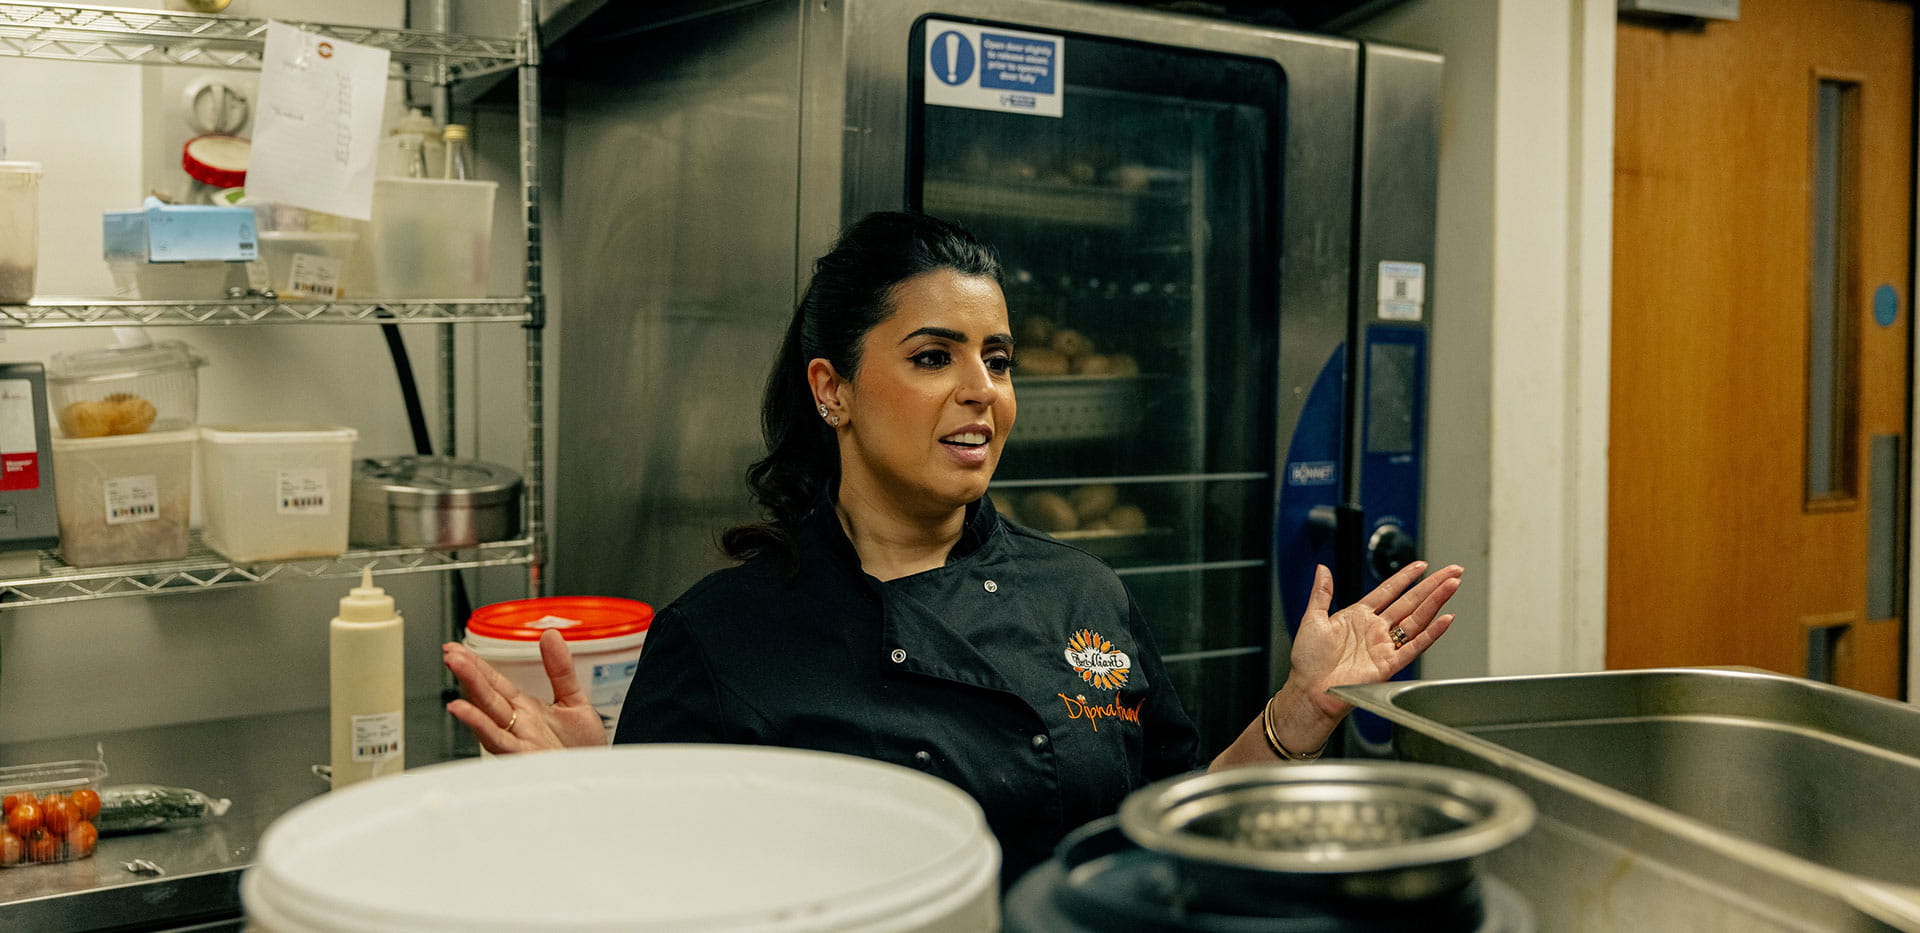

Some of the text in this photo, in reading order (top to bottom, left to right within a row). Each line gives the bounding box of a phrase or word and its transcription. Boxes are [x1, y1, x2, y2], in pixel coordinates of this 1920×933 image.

[983, 39, 1005, 50] Open
[1007, 42, 1024, 52] door
[987, 51, 996, 59] to
[1007, 63, 1016, 71] to
[999, 71, 1018, 81] door
[1071, 653, 1124, 668] Brilliant
[1058, 693, 1117, 732] Dipna
